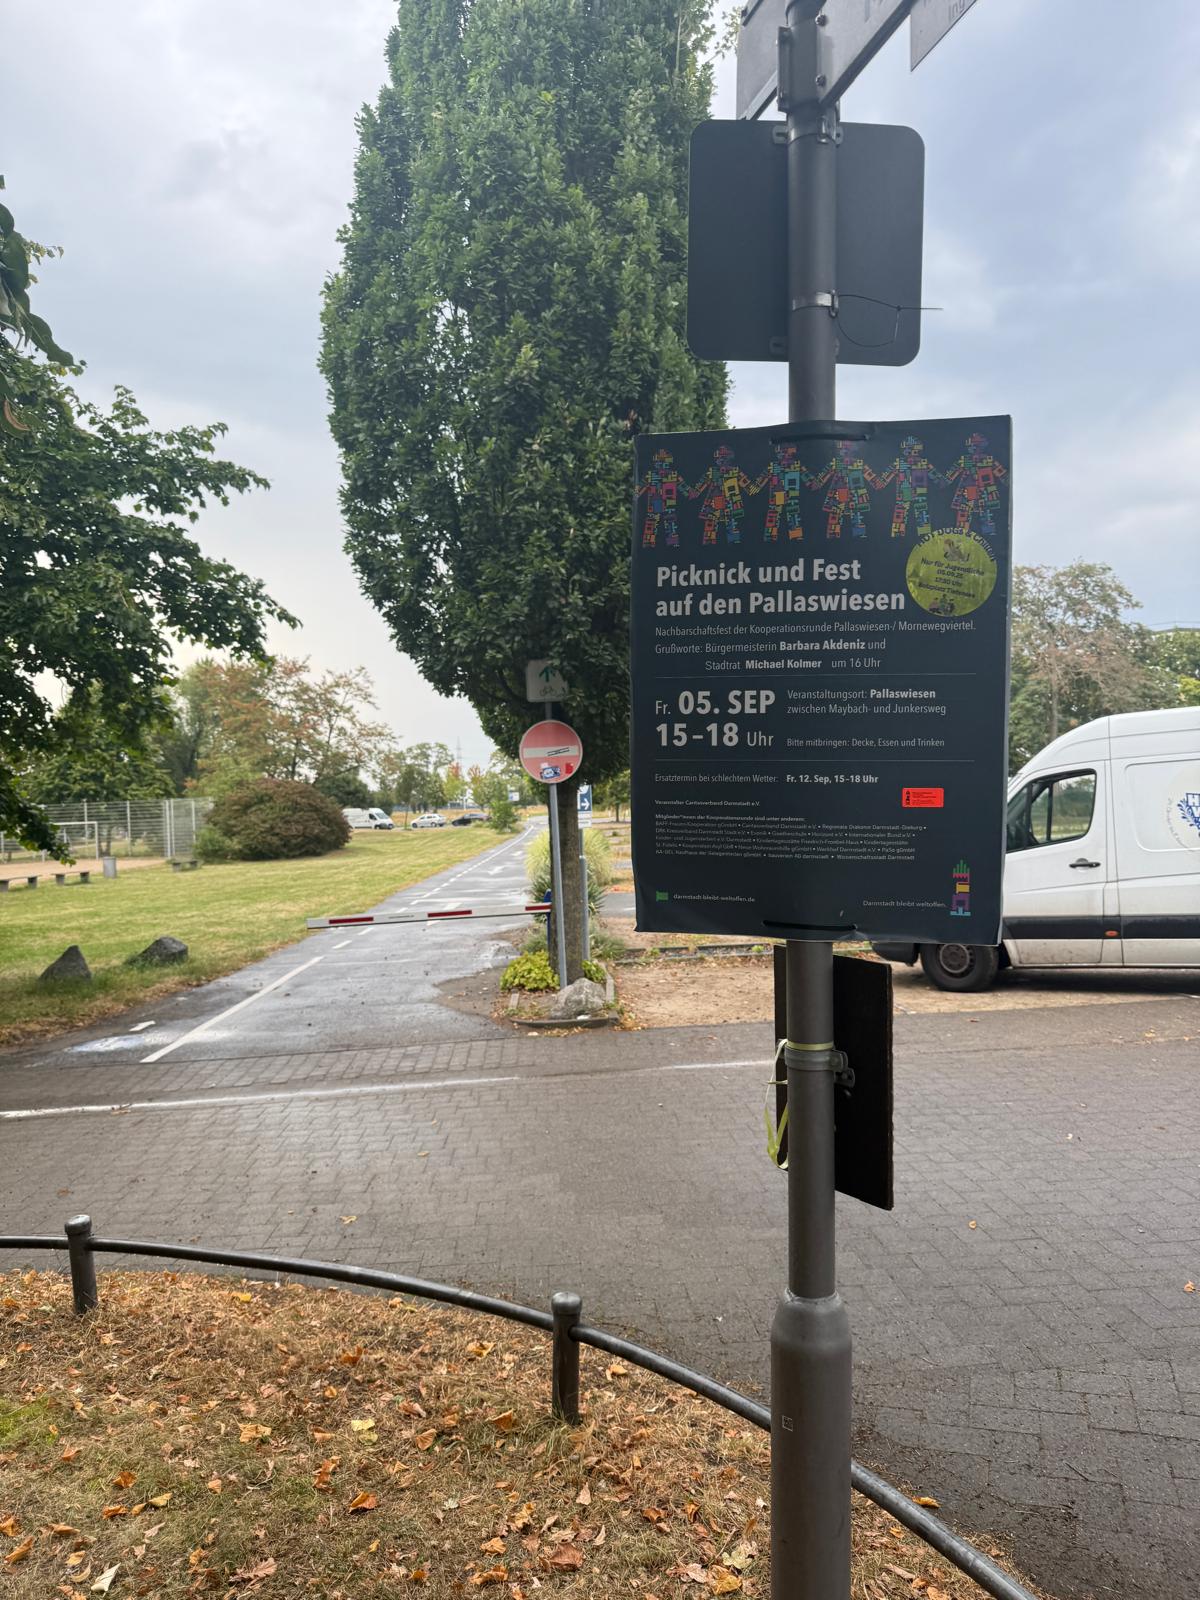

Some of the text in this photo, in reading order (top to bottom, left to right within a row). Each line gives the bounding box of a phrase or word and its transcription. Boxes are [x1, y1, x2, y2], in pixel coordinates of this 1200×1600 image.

[657, 558, 861, 587] Picknick und Fest
[656, 588, 905, 616] auf den Pallaswiesen
[655, 625, 731, 636] Nachbarschaftsfest
[733, 625, 747, 635] der
[749, 623, 832, 636] Kooperationsrunde
[898, 620, 977, 633] Mornewegviertel.
[655, 638, 886, 655] Grußworte: Bürgermeisterin Barbara Akdeniz und
[705, 657, 881, 671] Stadtrat Michael Kolmer um 16 Uhr
[787, 688, 936, 701] Veranstaltungsort: Pallaswiesen
[655, 689, 776, 715] Fr. 05. SEP
[787, 703, 946, 716] zwischen Maybach- und Junkersweg
[747, 731, 774, 746] Uhr
[787, 738, 944, 748] Bitte mitbringen: Decke, Essen und Trinken
[655, 773, 697, 782] Ersatztermin
[698, 773, 710, 782] bei
[711, 773, 751, 783] schlechtem
[786, 775, 797, 783] Fr.
[798, 775, 812, 783] 12.
[813, 775, 832, 785] Sep,
[862, 774, 879, 783] Uhr
